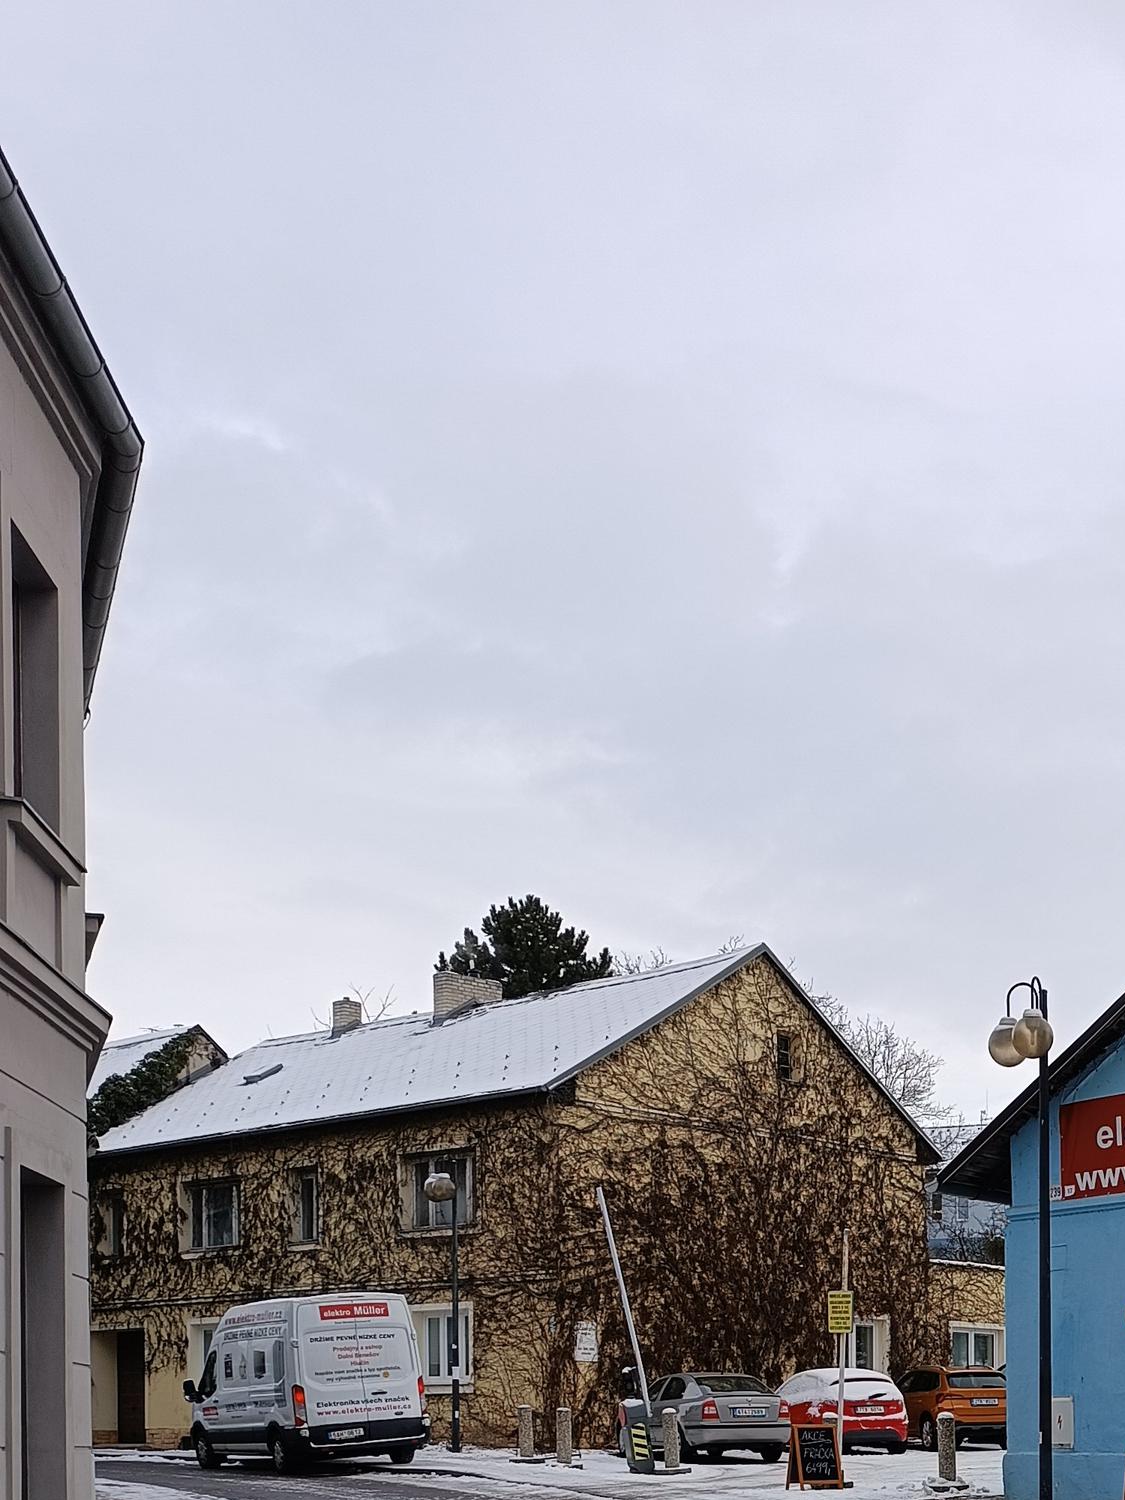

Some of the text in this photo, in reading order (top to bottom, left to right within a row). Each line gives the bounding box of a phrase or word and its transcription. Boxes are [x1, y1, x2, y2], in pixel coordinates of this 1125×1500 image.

[323, 1305, 385, 1317] elektro Müller
[316, 1399, 360, 1409] Elektronika
[361, 1397, 383, 1405] všech
[316, 1403, 412, 1417] www.elektro-muller.cz
